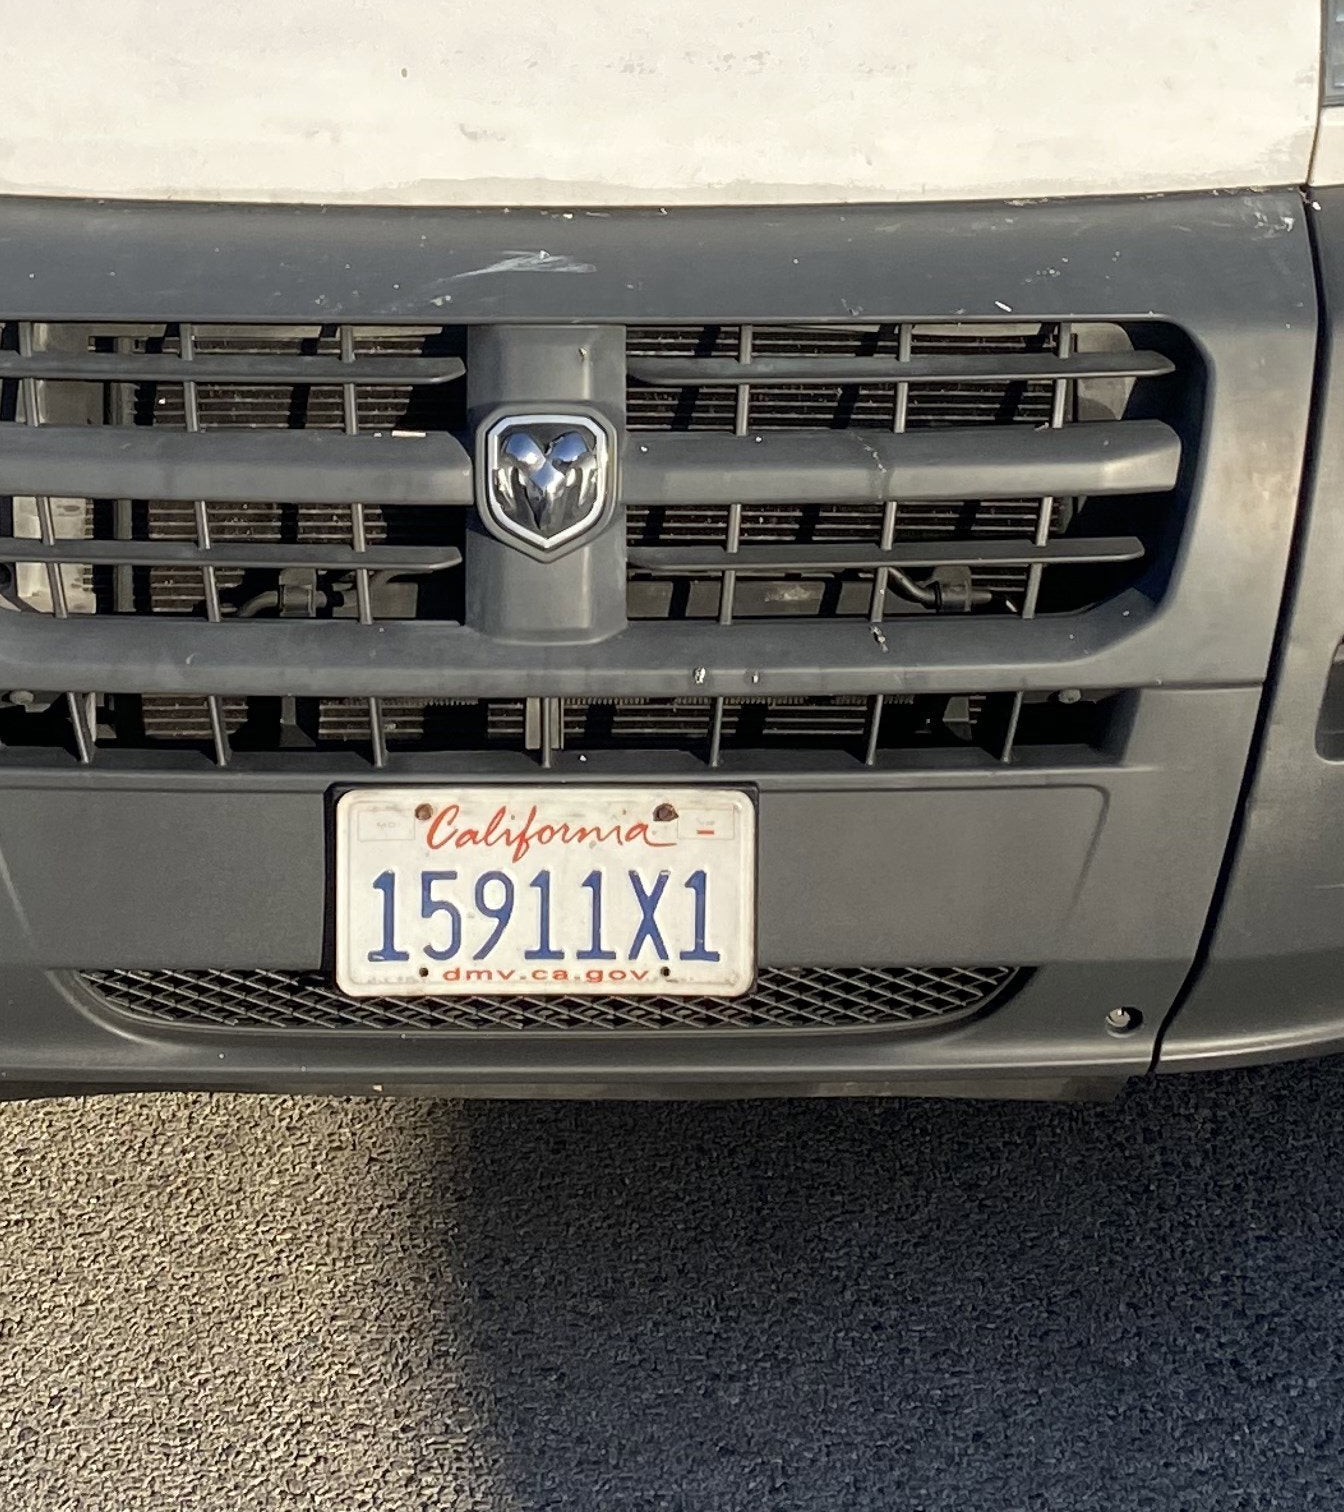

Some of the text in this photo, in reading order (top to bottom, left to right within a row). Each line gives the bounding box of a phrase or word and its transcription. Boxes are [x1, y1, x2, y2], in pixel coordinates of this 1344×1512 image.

[425, 804, 677, 863] California
[367, 870, 721, 962] 15911X1
[442, 967, 650, 983] dmv.ca.gov
